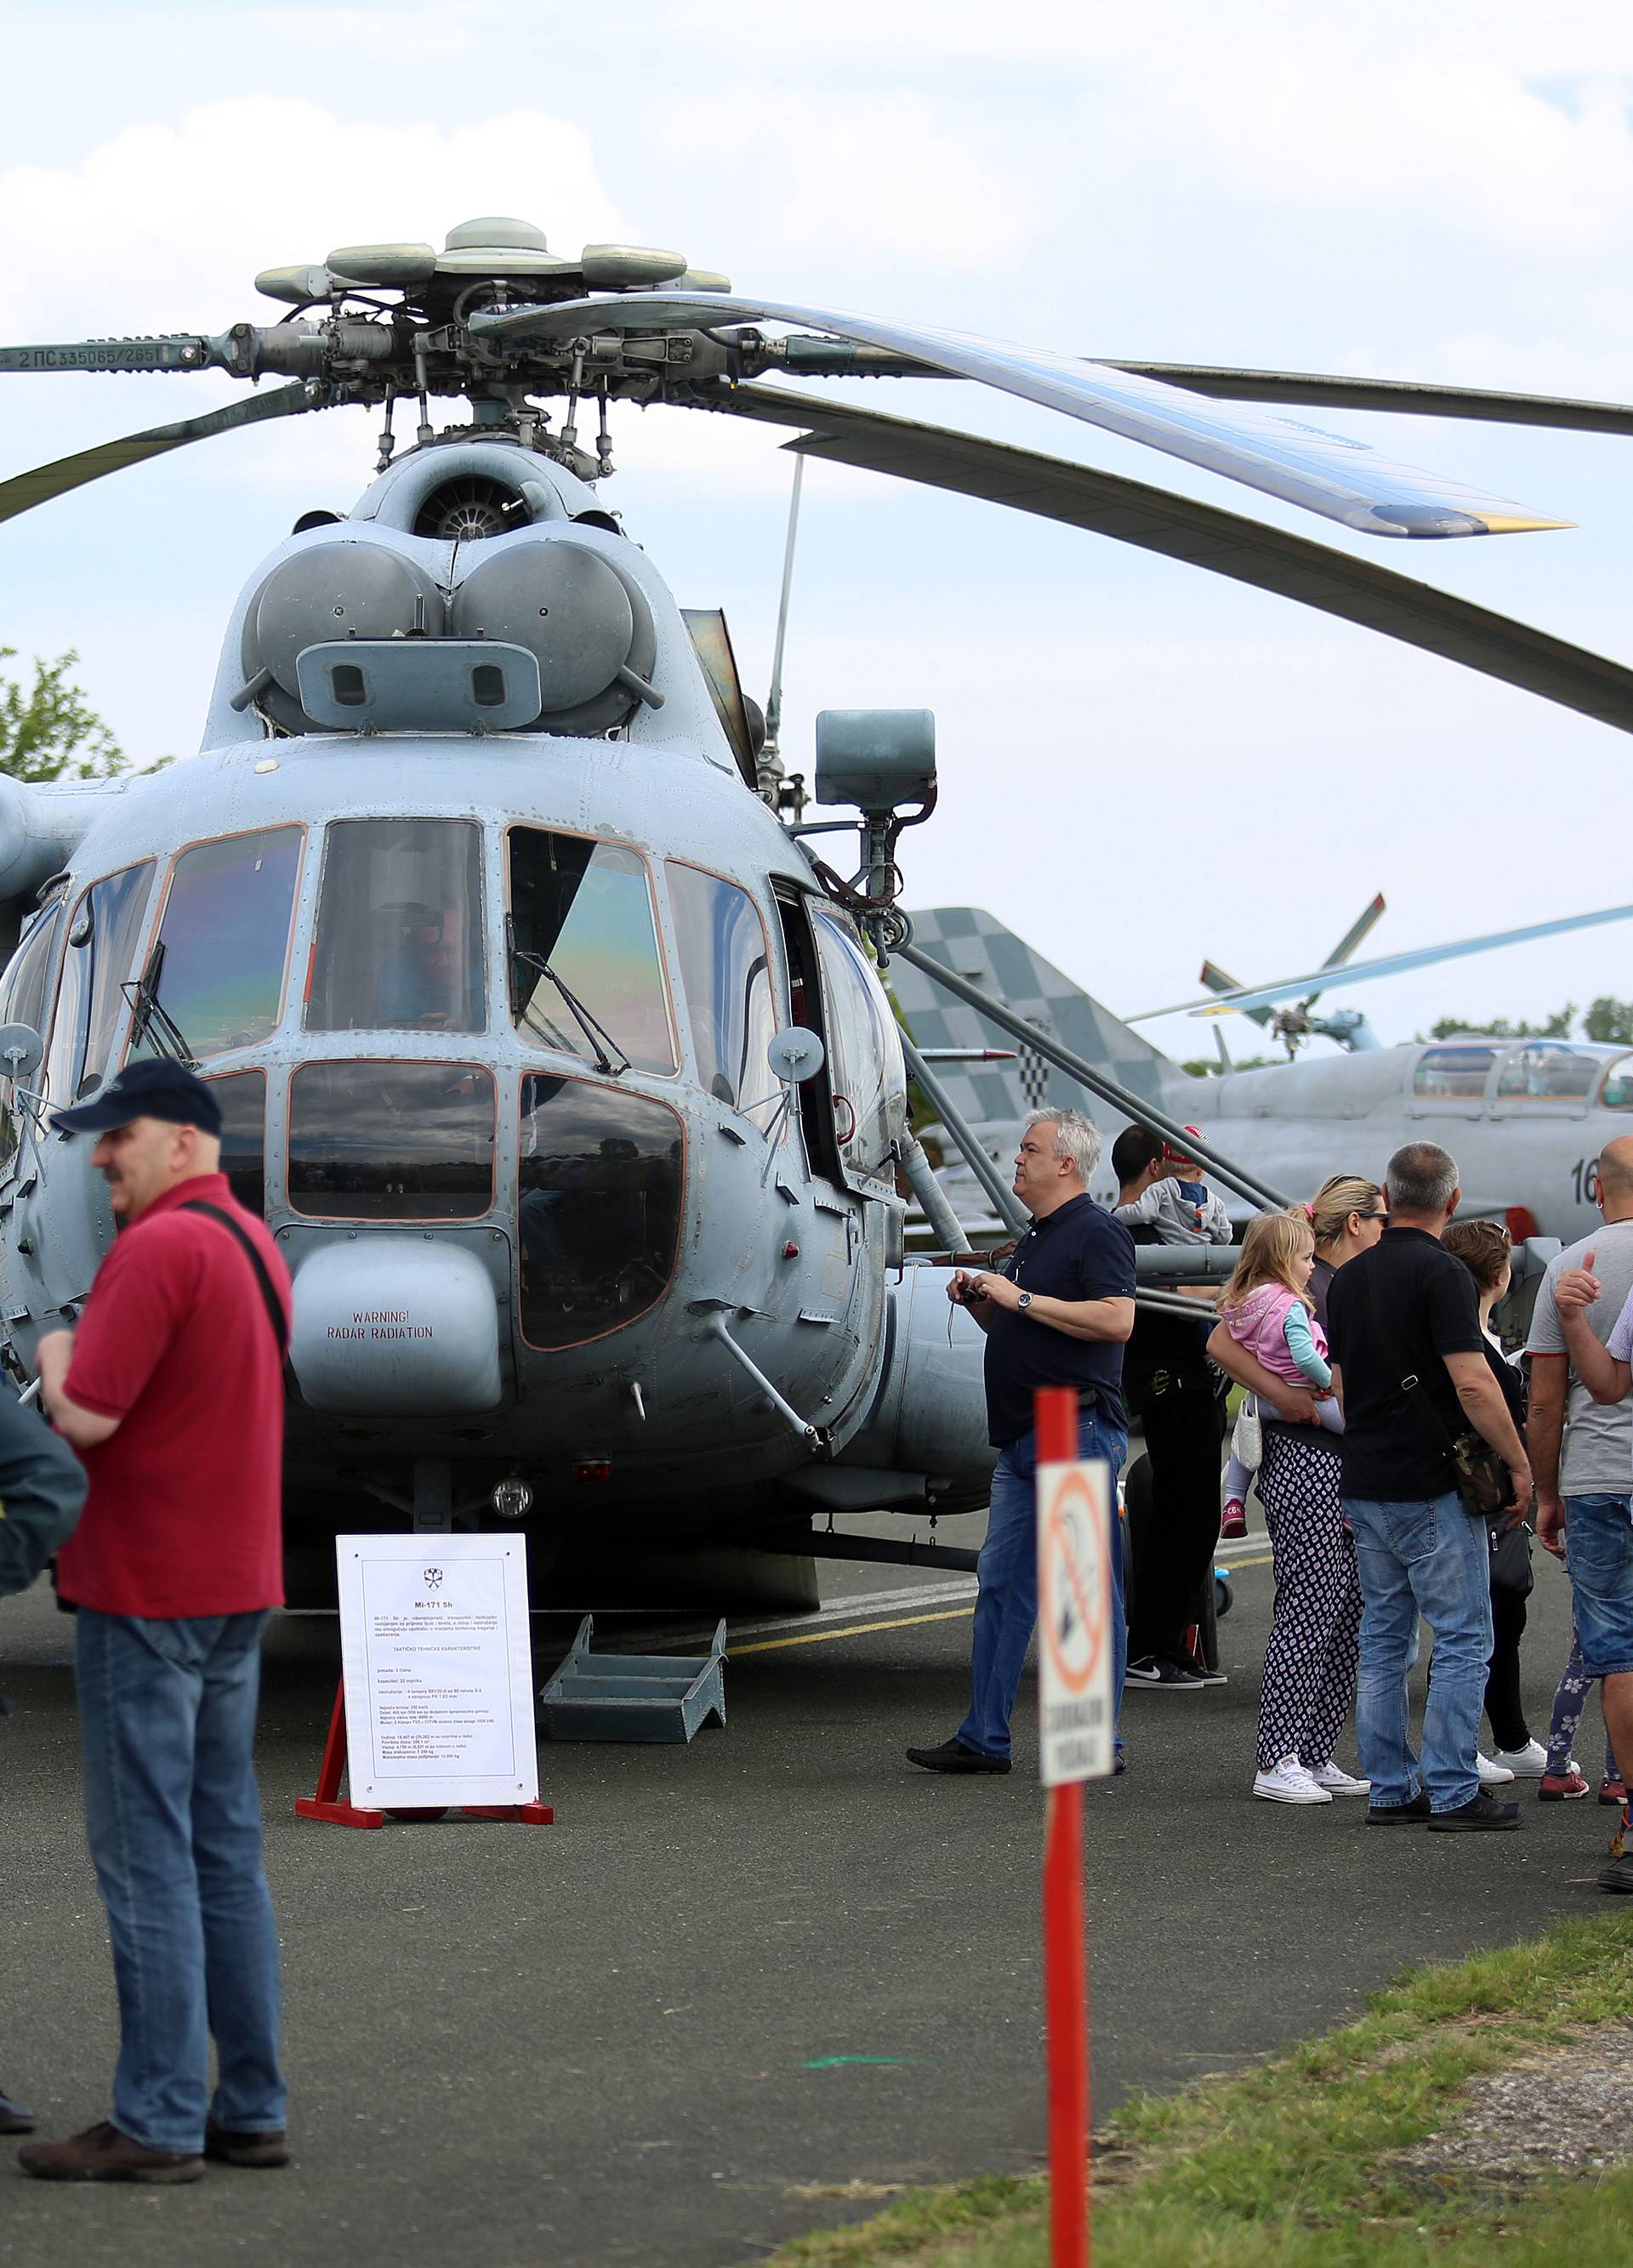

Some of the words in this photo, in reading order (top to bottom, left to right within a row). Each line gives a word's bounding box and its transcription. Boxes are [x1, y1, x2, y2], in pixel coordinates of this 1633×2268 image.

[353, 1310, 409, 1323] WARNING!
[327, 1327, 365, 1339] RADAR
[371, 1327, 433, 1339] RADIATION
